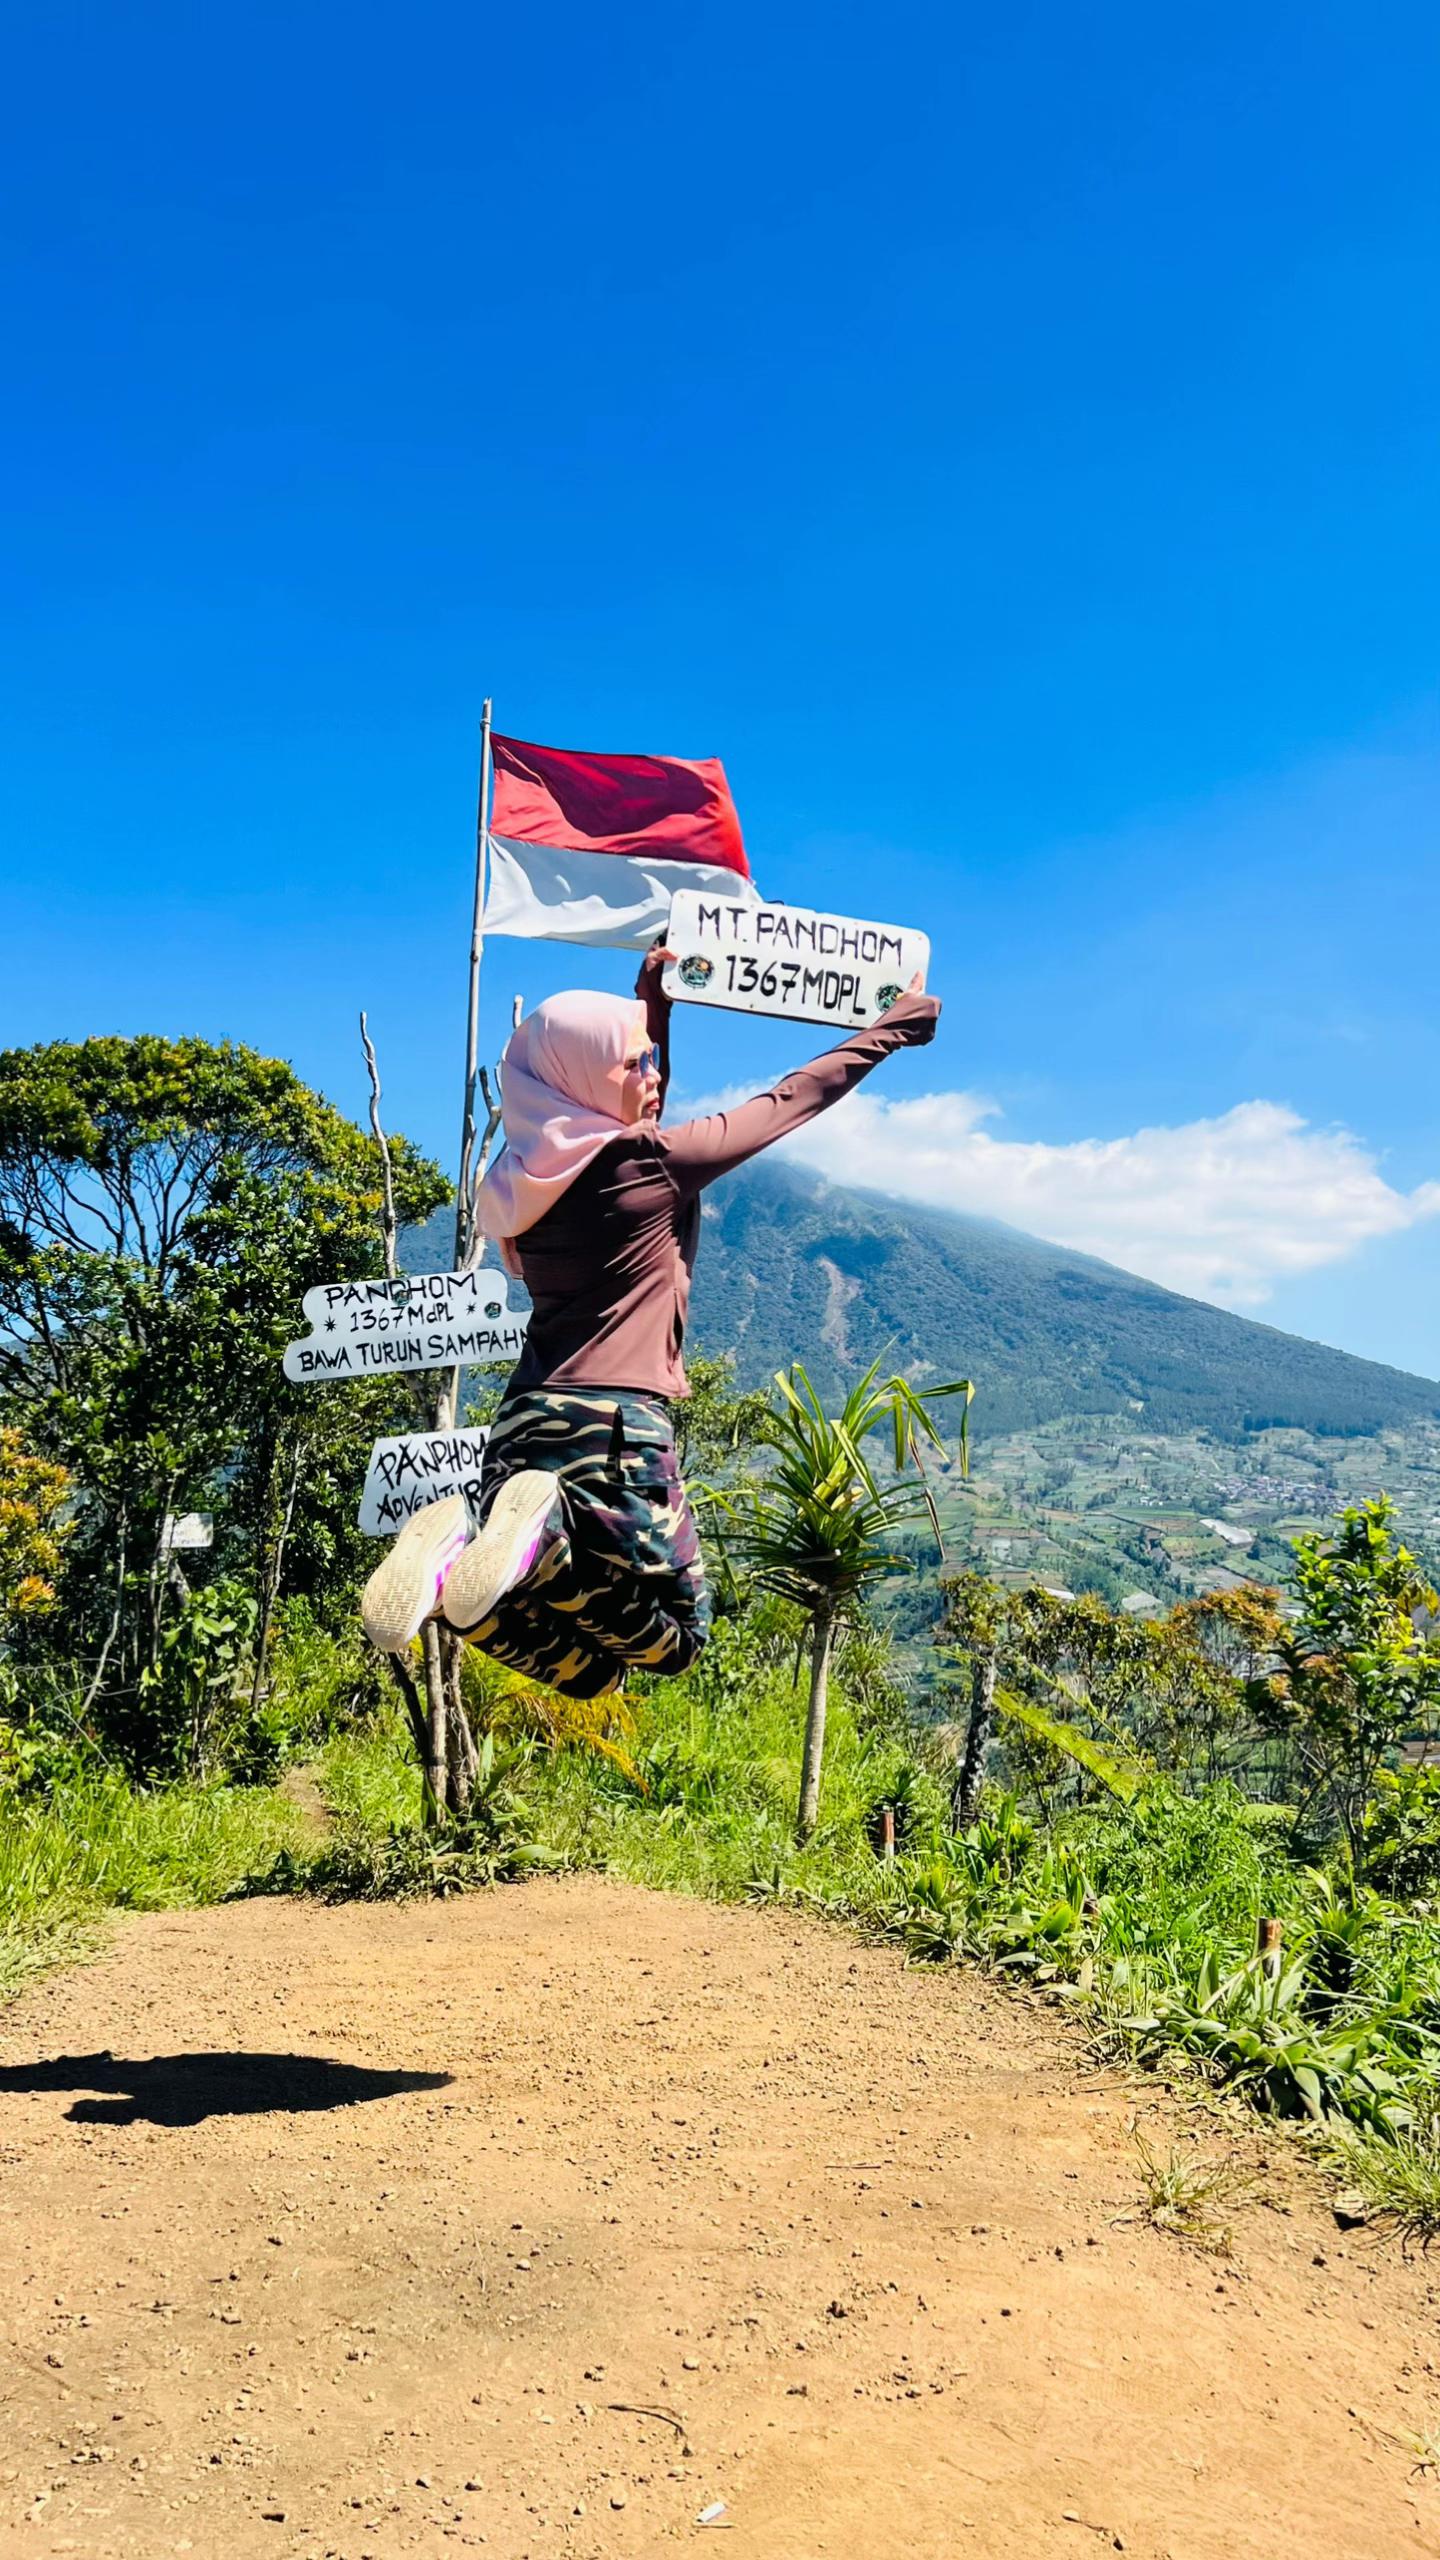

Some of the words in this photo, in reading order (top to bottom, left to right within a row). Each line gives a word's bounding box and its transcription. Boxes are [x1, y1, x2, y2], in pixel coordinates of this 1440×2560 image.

[324, 1273, 477, 1309] PANDHOM
[297, 1350, 352, 1372] BAWA
[356, 1337, 422, 1366] TURUN
[374, 1433, 486, 1490] PANDHOM
